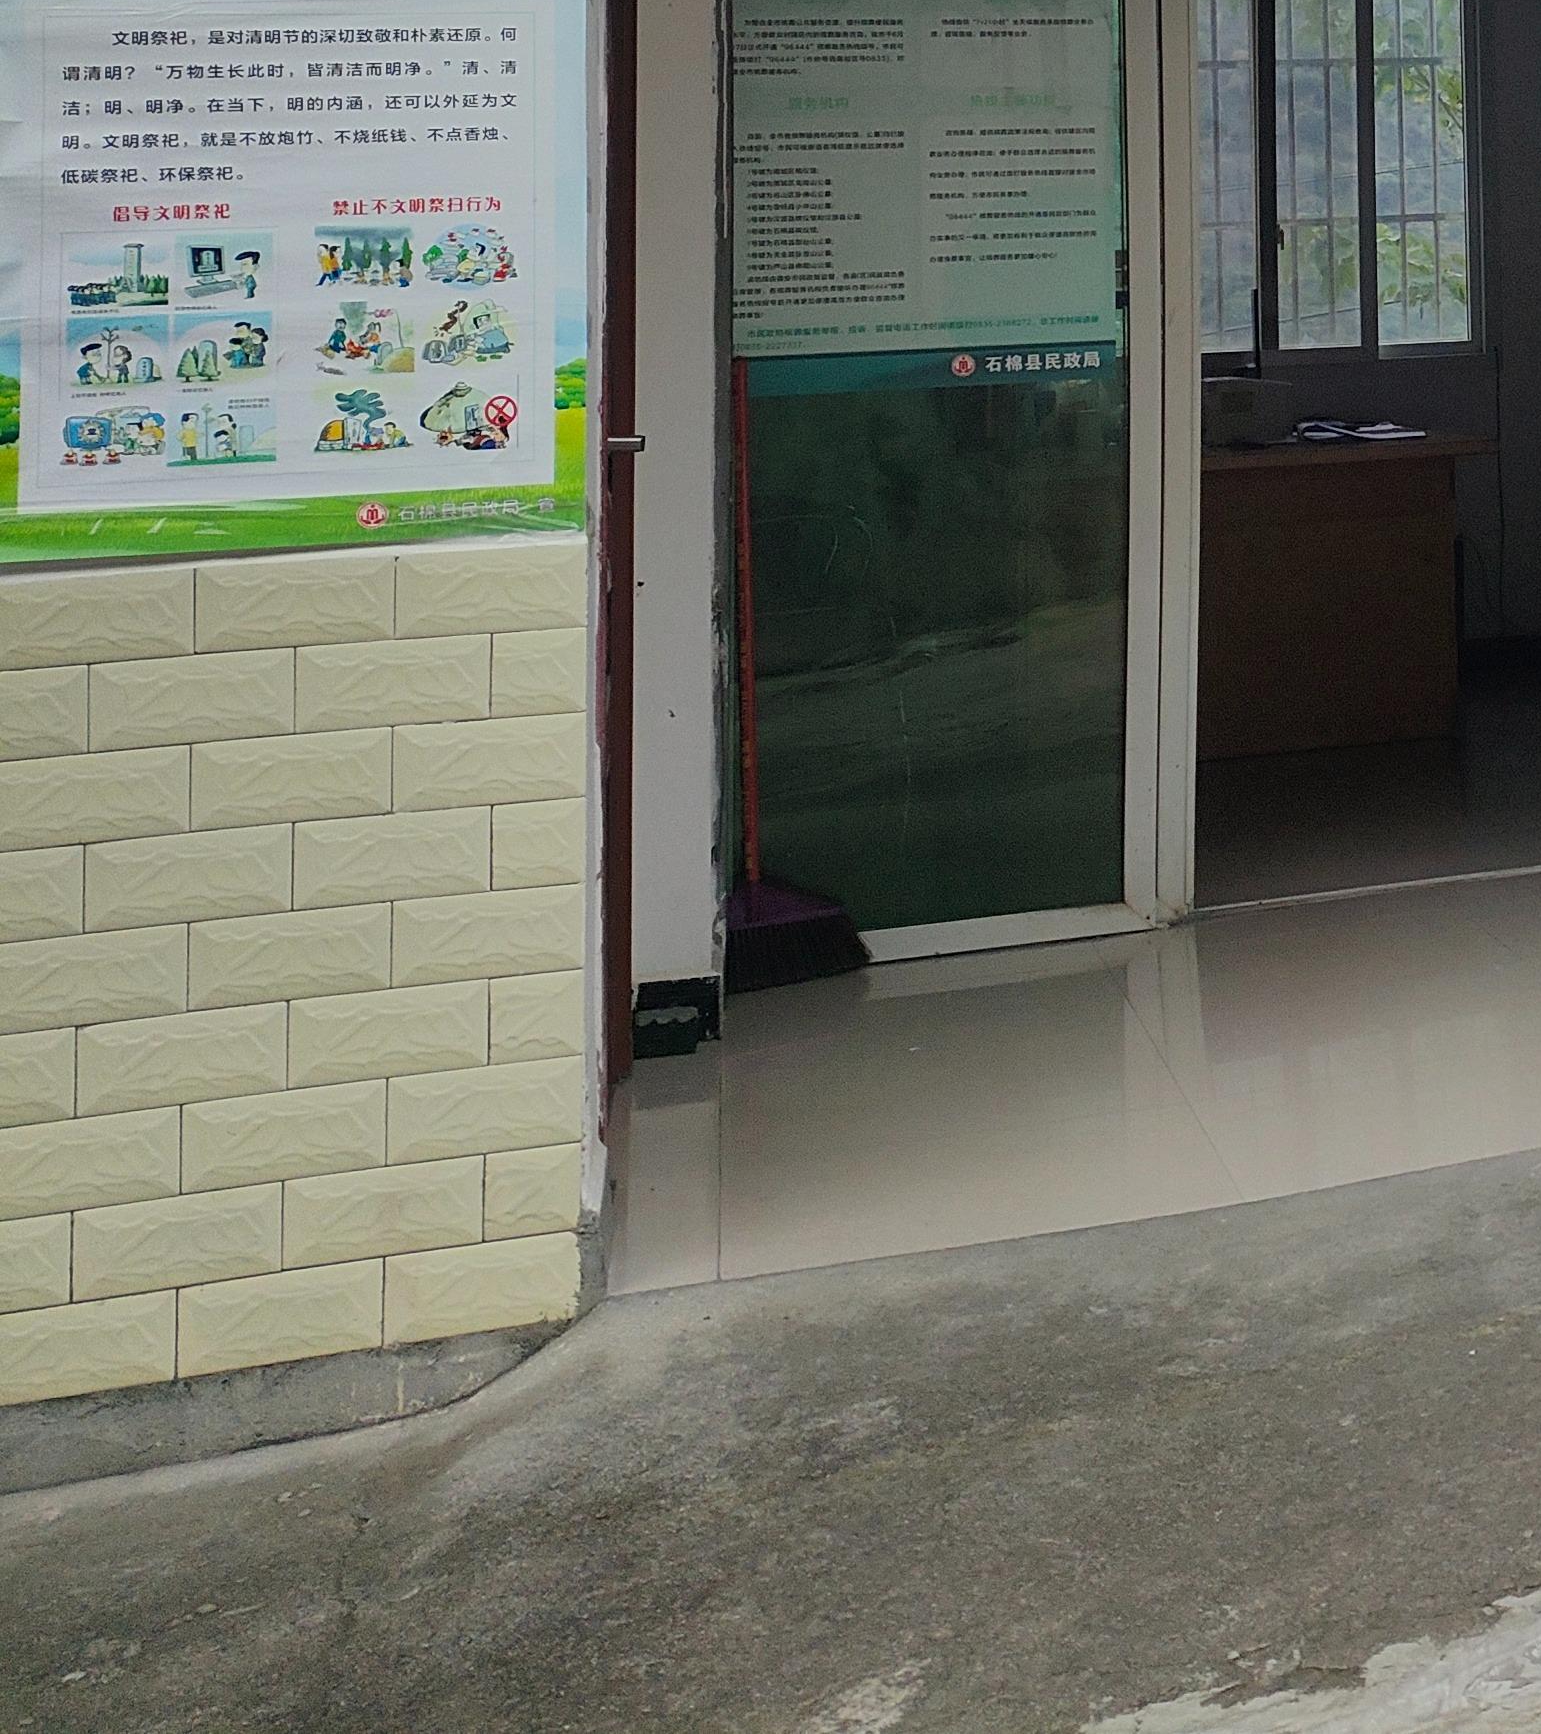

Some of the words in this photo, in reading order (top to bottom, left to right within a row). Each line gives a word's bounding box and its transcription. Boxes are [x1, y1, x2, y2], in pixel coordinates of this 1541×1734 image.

[113, 203, 231, 222] 倡导文明祭祀
[333, 196, 502, 216] 禁止不文明祭扫行为
[984, 351, 1101, 373] 石棉县民政局
